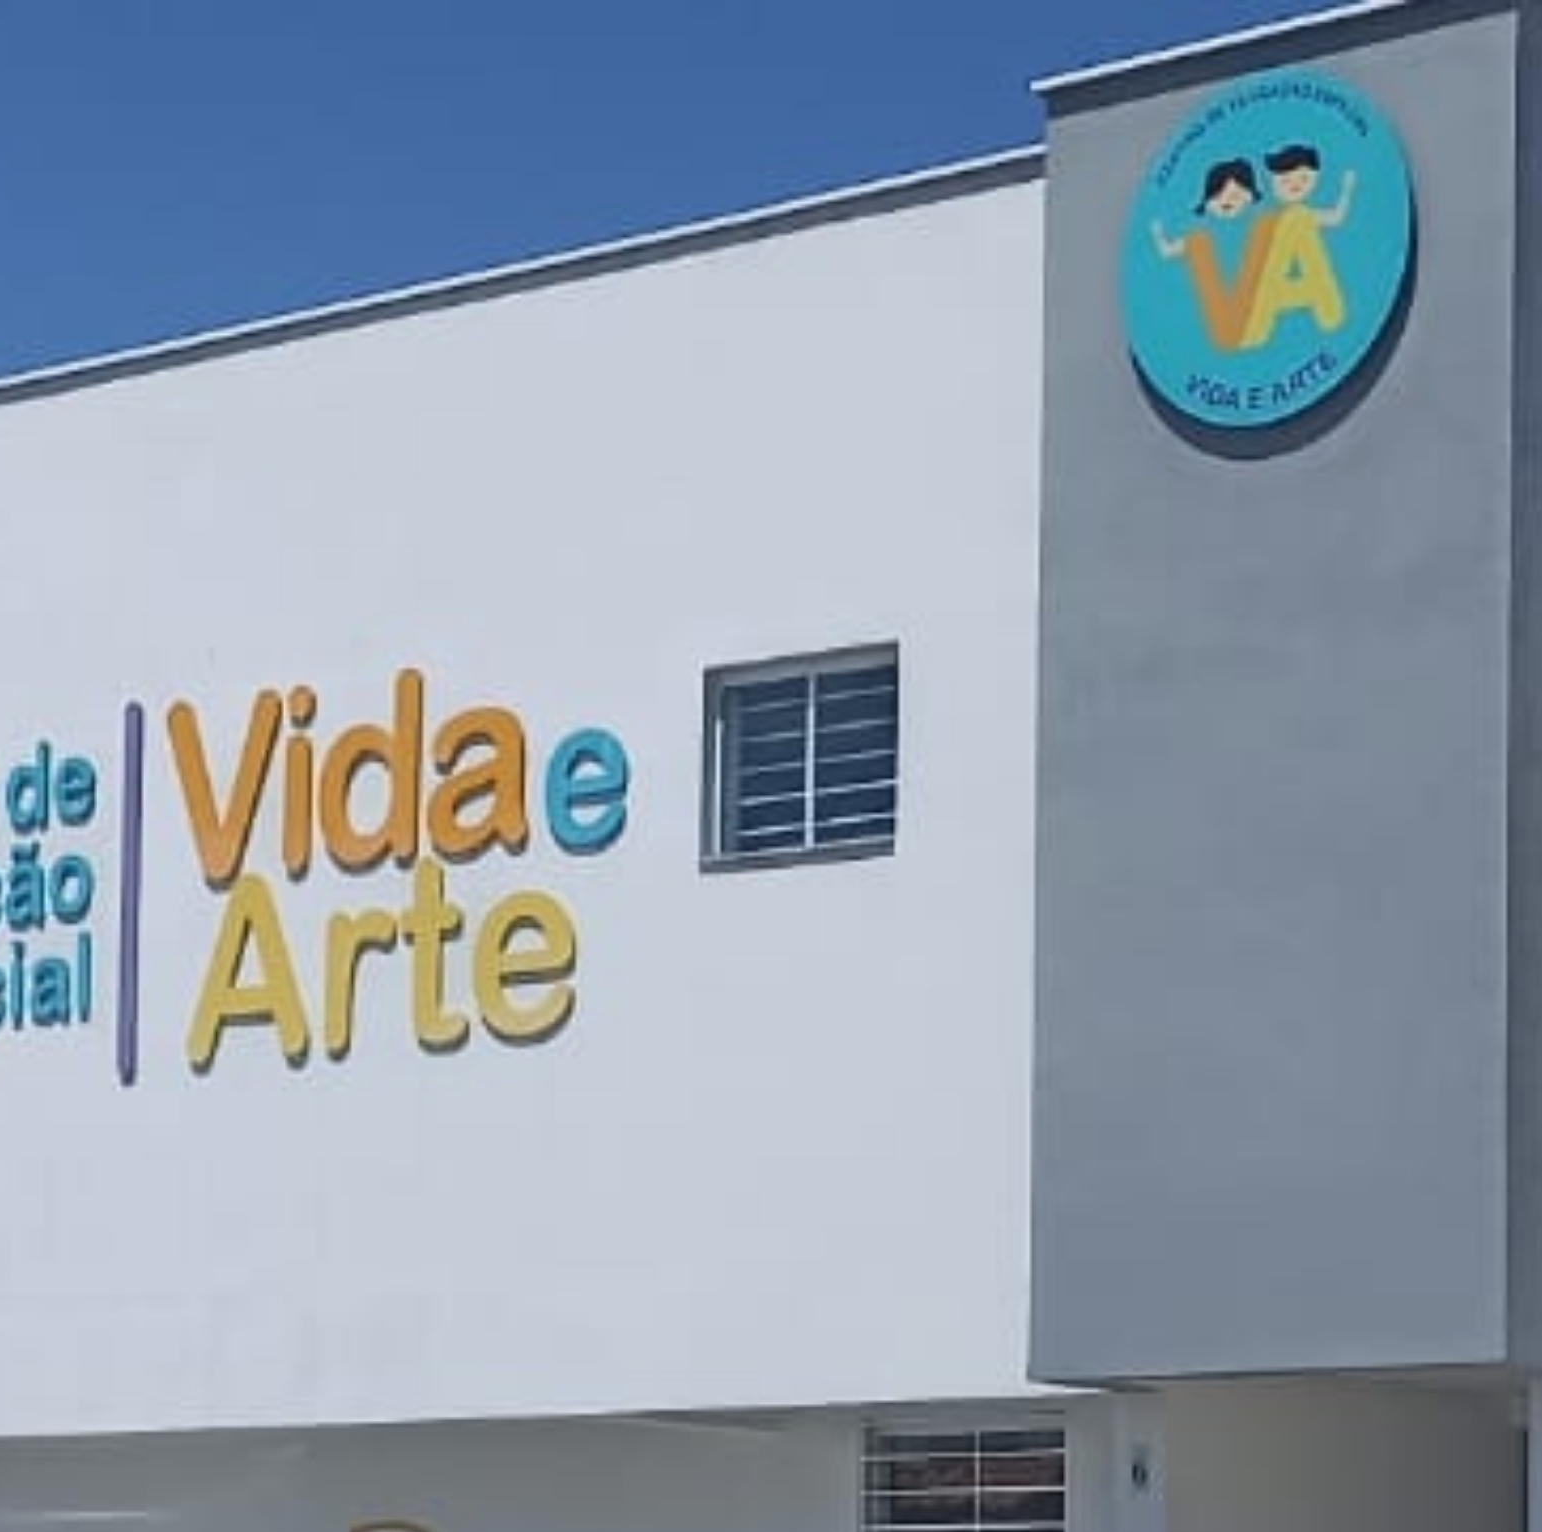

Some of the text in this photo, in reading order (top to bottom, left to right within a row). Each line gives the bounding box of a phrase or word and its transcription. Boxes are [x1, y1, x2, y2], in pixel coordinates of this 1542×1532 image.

[1186, 213, 1344, 349] VA
[1247, 386, 1263, 410] E
[6, 739, 97, 833] de
[167, 668, 631, 890] Vida e
[186, 858, 577, 1074] Arte
